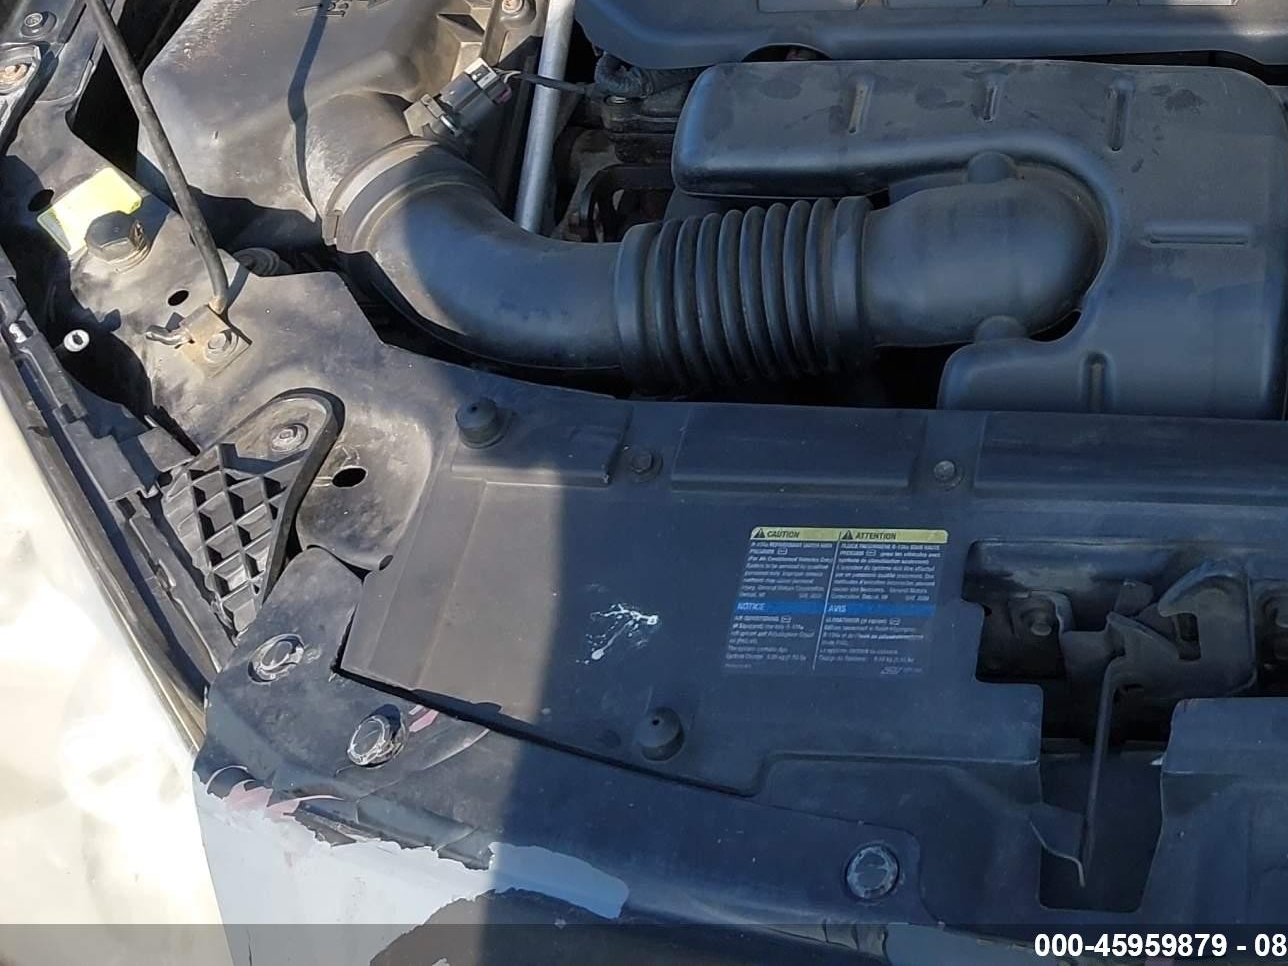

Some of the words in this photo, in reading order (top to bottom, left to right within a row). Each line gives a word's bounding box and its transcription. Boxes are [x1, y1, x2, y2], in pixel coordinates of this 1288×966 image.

[767, 530, 800, 539] CAUTION
[855, 532, 896, 540] ATTENTION
[737, 602, 766, 611] NOTICE
[827, 604, 847, 613] AVIS
